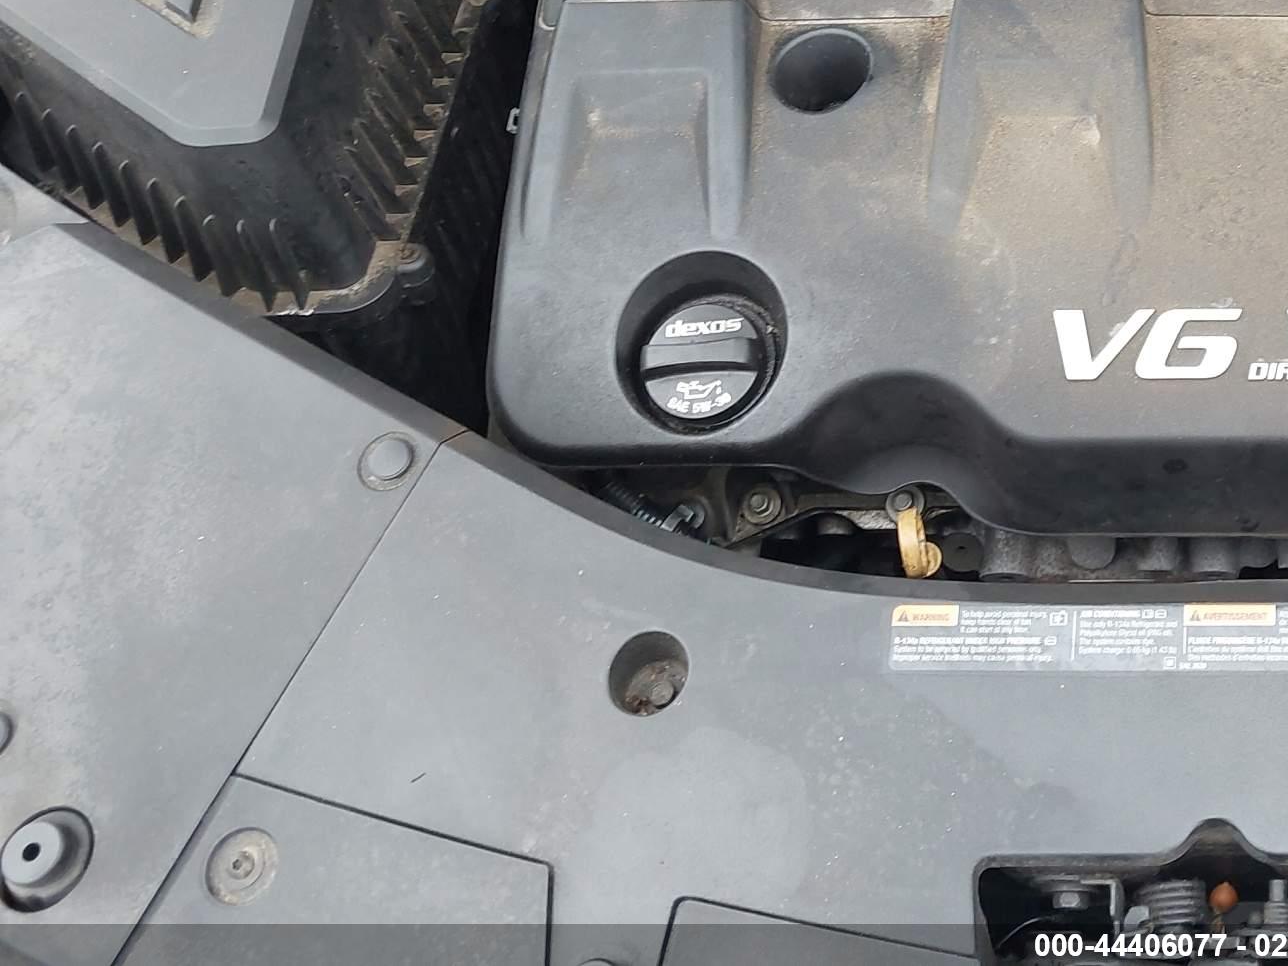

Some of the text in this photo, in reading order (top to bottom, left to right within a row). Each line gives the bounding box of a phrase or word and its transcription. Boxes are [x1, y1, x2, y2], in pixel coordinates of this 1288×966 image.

[665, 318, 744, 337] dexos
[1052, 308, 1243, 381] V6
[667, 392, 731, 413] SAE 5W-30
[912, 613, 951, 622] WARNING
